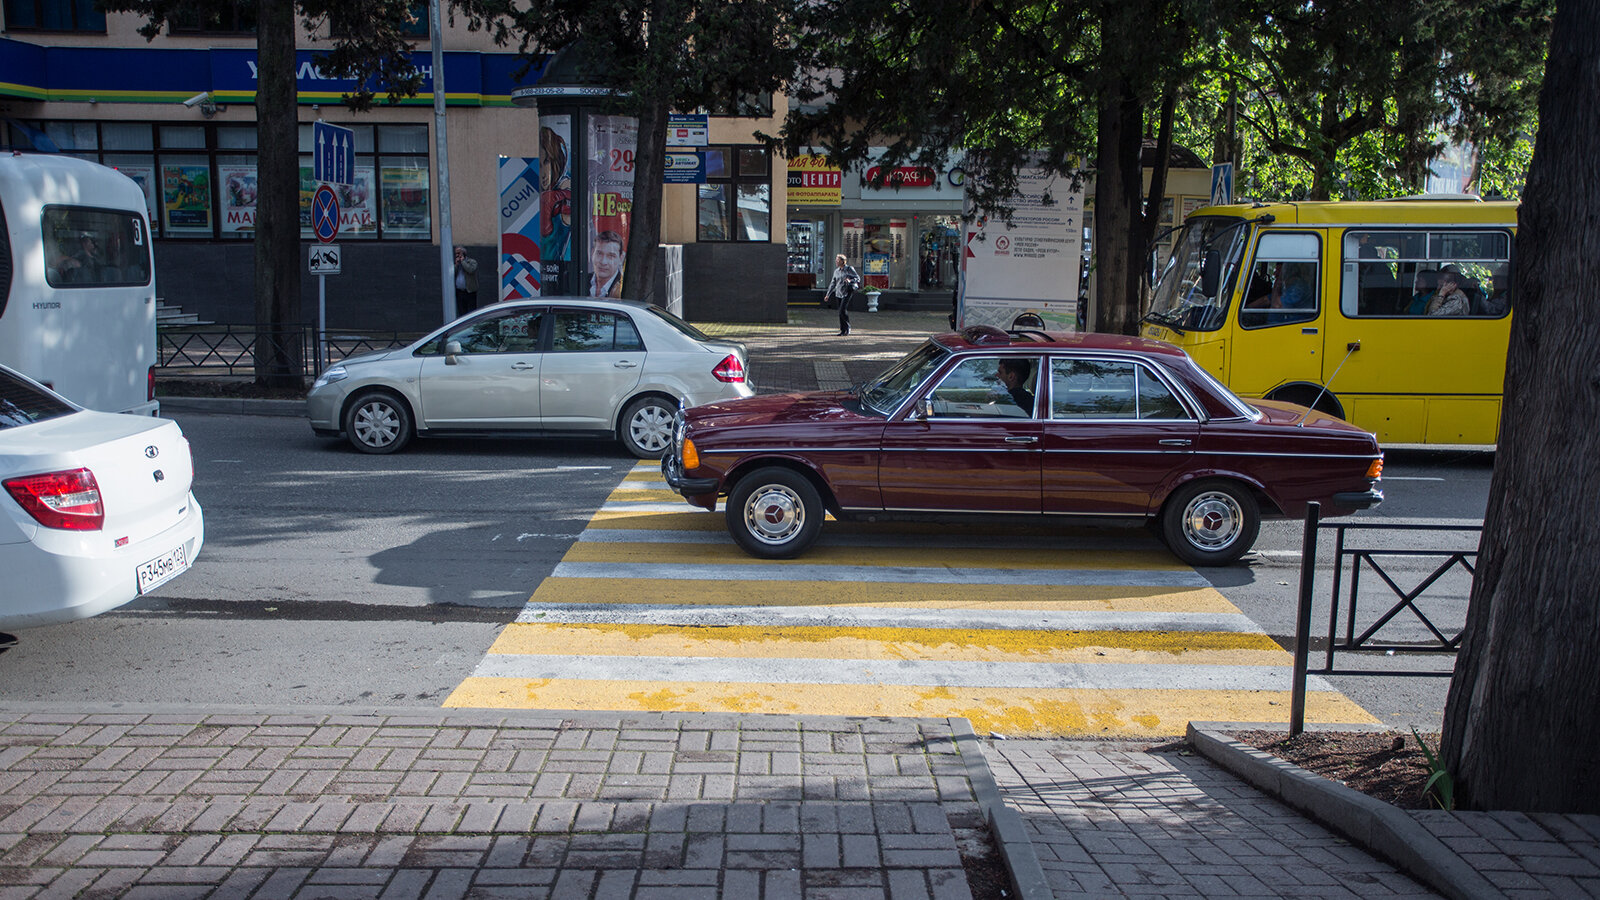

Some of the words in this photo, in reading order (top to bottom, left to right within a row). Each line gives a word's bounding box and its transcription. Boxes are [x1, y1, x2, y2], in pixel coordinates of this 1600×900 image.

[609, 149, 634, 172] 29
[803, 173, 839, 187] ЦЕНТР
[501, 184, 535, 218] СОЧИ
[340, 210, 371, 225] МАЙ
[173, 547, 184, 561] 123
